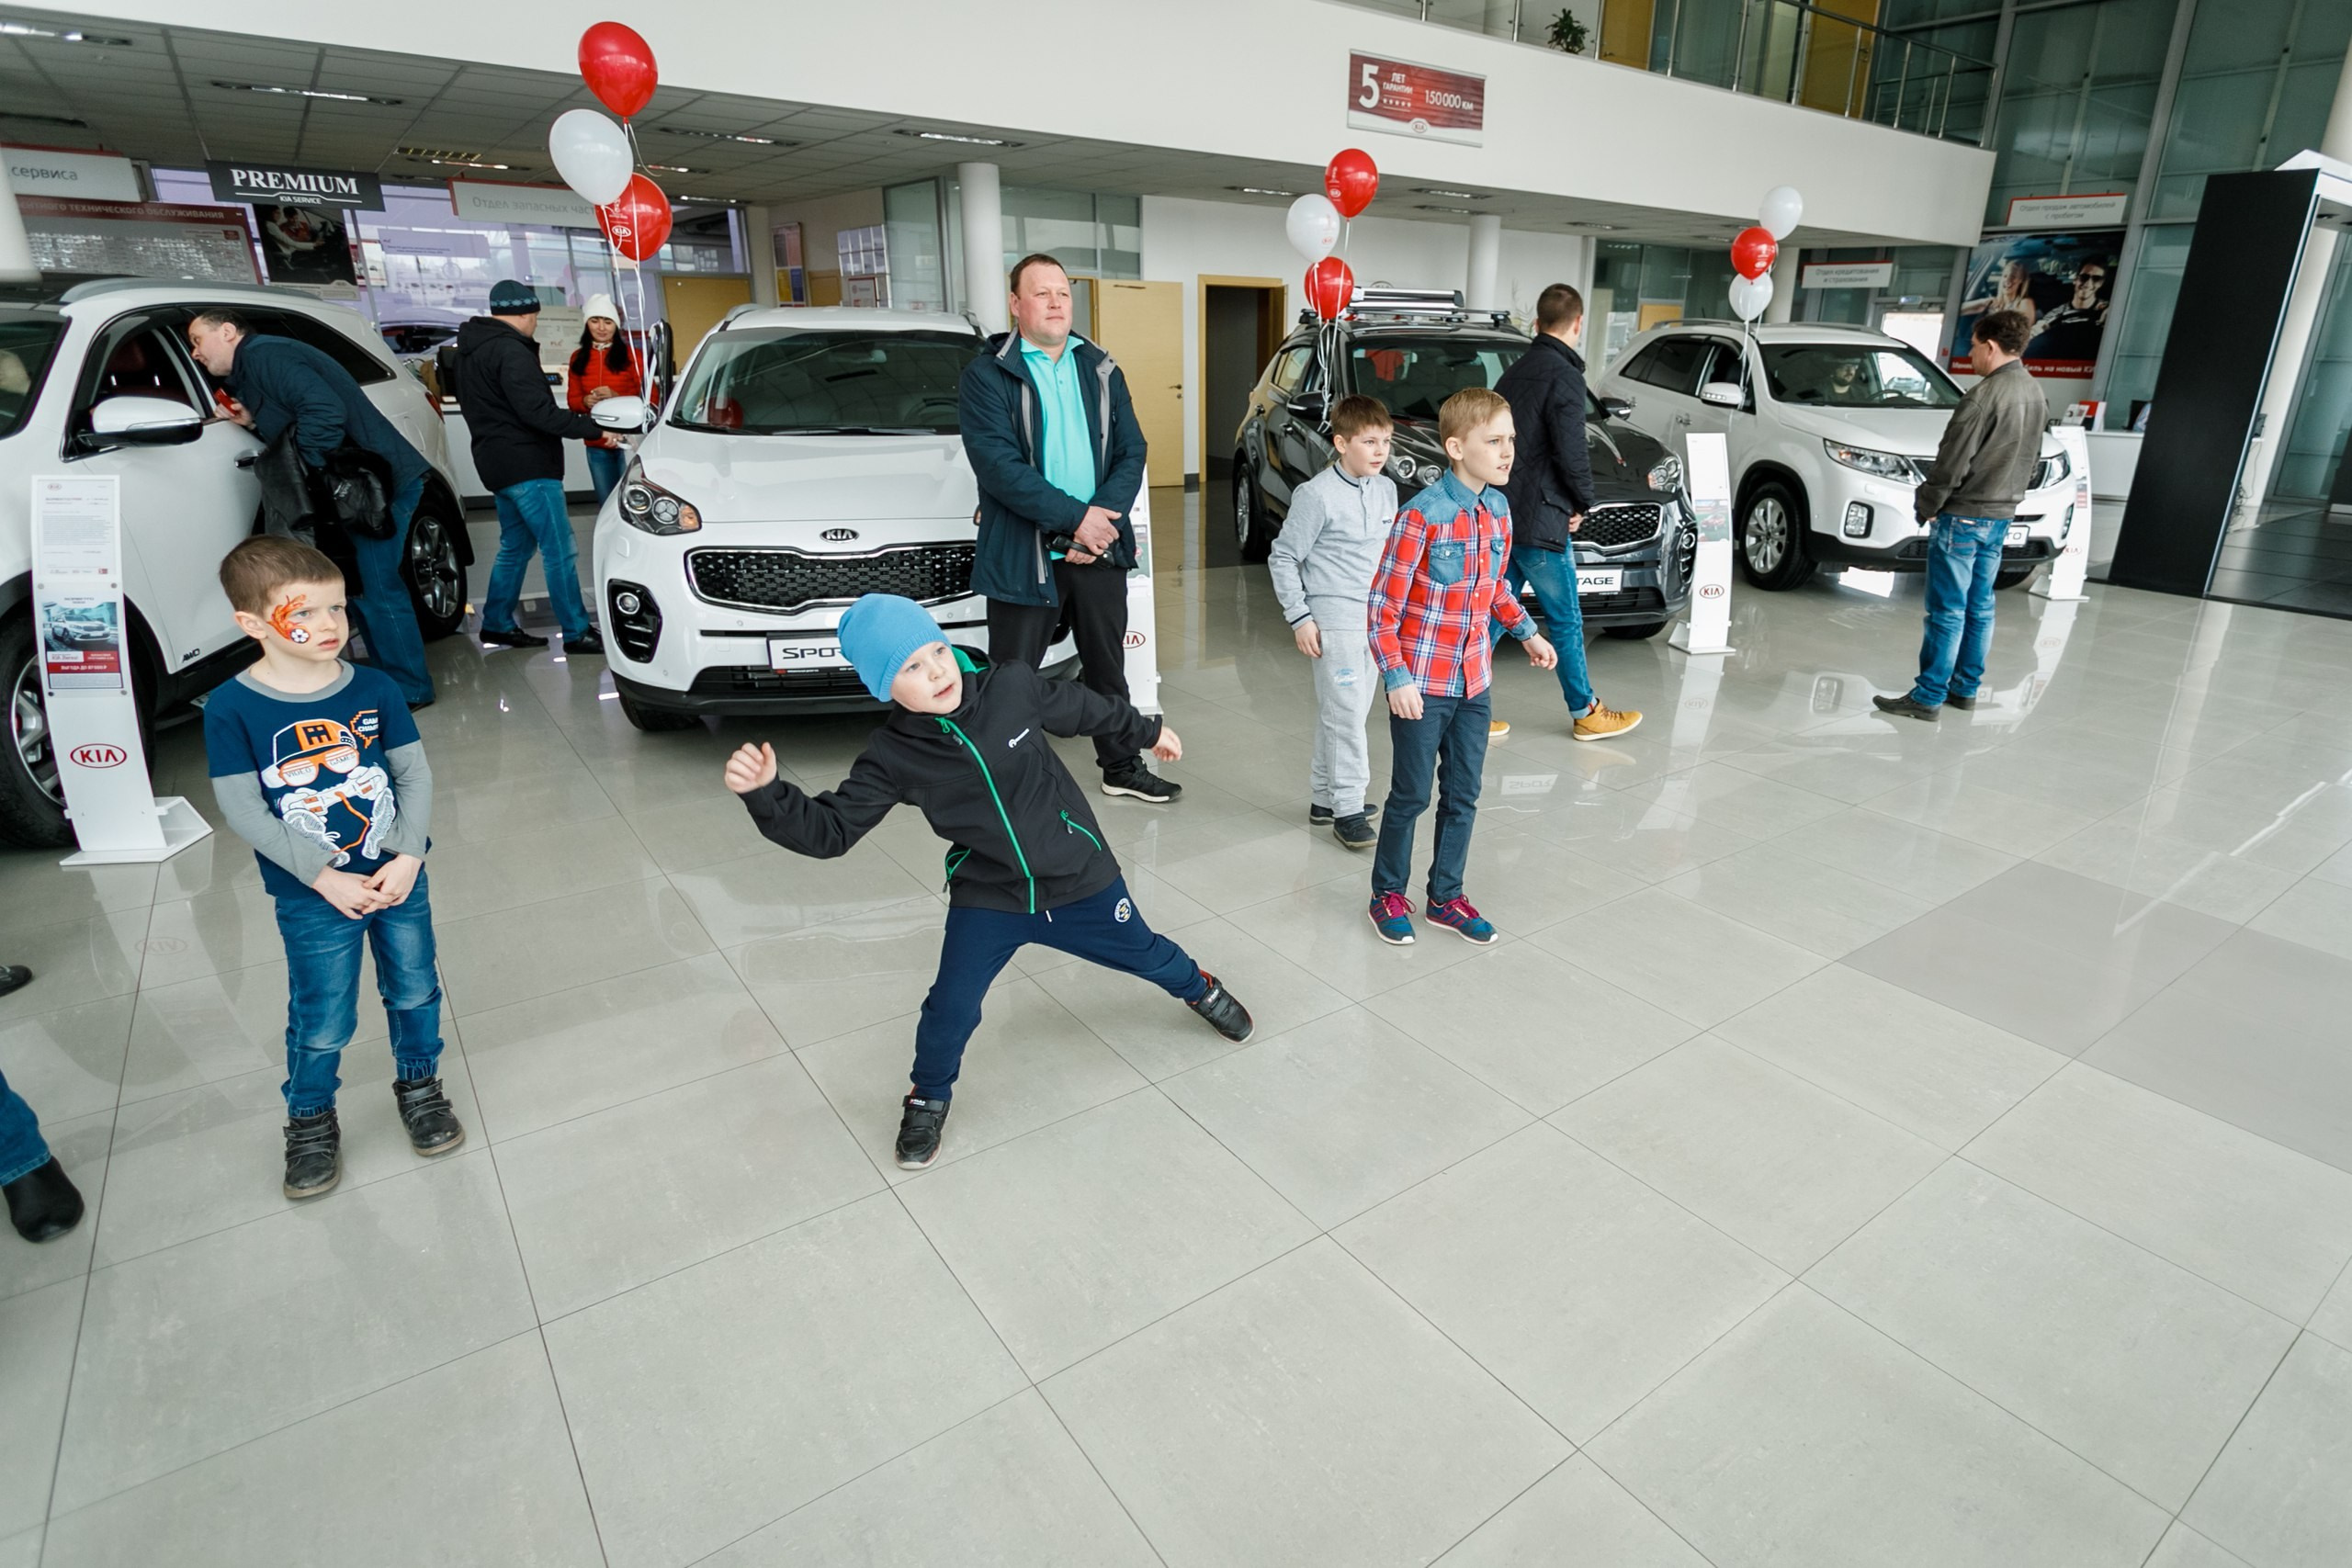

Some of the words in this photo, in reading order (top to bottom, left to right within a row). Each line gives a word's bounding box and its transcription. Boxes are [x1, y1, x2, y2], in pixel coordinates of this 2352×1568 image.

[1358, 62, 1380, 109] 5
[1391, 72, 1406, 84] ЛЕТ
[11, 166, 78, 181] сервиса
[230, 168, 360, 195] PREMIUM
[292, 197, 322, 205] SERVICE
[472, 197, 509, 209] Отдел
[513, 201, 569, 214] запасных
[70, 203, 145, 215] ТЕХНИЧЕСКОГО
[146, 207, 225, 220] ОБСЛУЖИВАНИЯ
[826, 529, 854, 540] KIA
[182, 648, 200, 663] AWD
[79, 749, 119, 763] KIA
[285, 767, 312, 778] VIDEO
